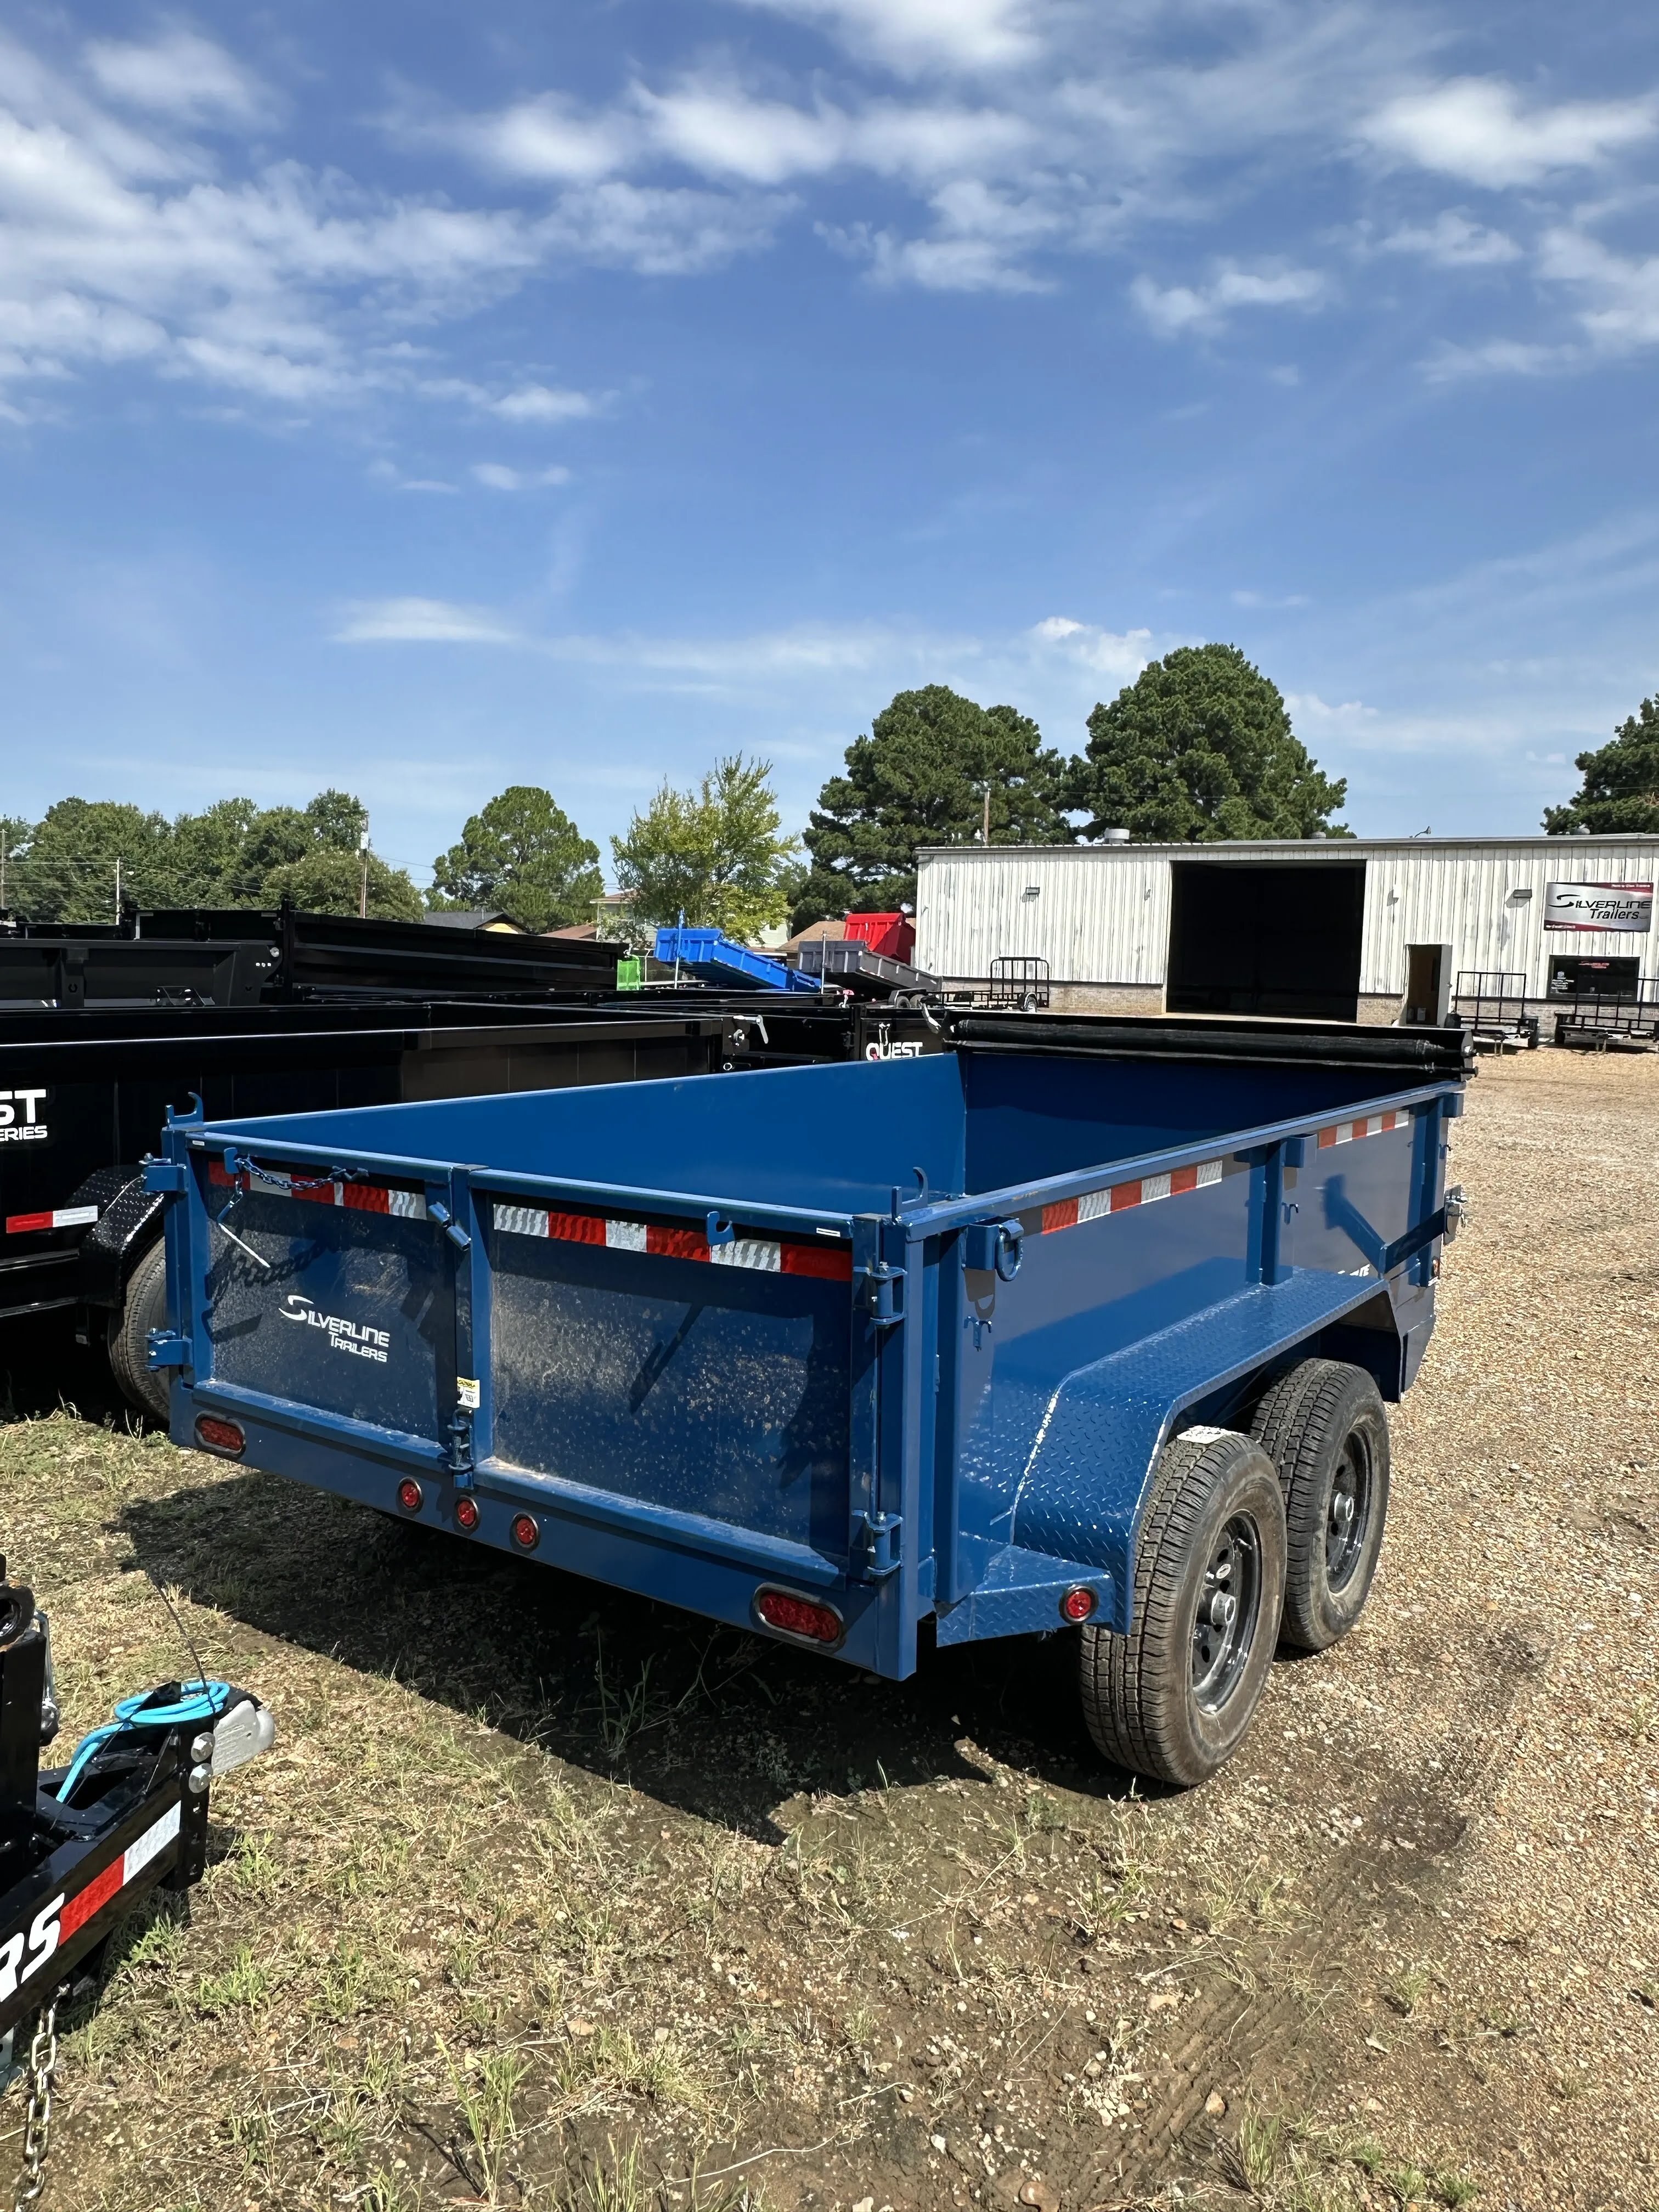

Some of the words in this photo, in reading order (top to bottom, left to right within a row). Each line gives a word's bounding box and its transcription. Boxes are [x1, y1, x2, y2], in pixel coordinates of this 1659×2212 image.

[1548, 894, 1652, 909] SILVERLINE
[1589, 908, 1640, 920] Trailers
[866, 1042, 923, 1061] QUEST
[278, 1295, 390, 1347] SILVERLINE
[328, 1331, 388, 1362] TRAILERS
